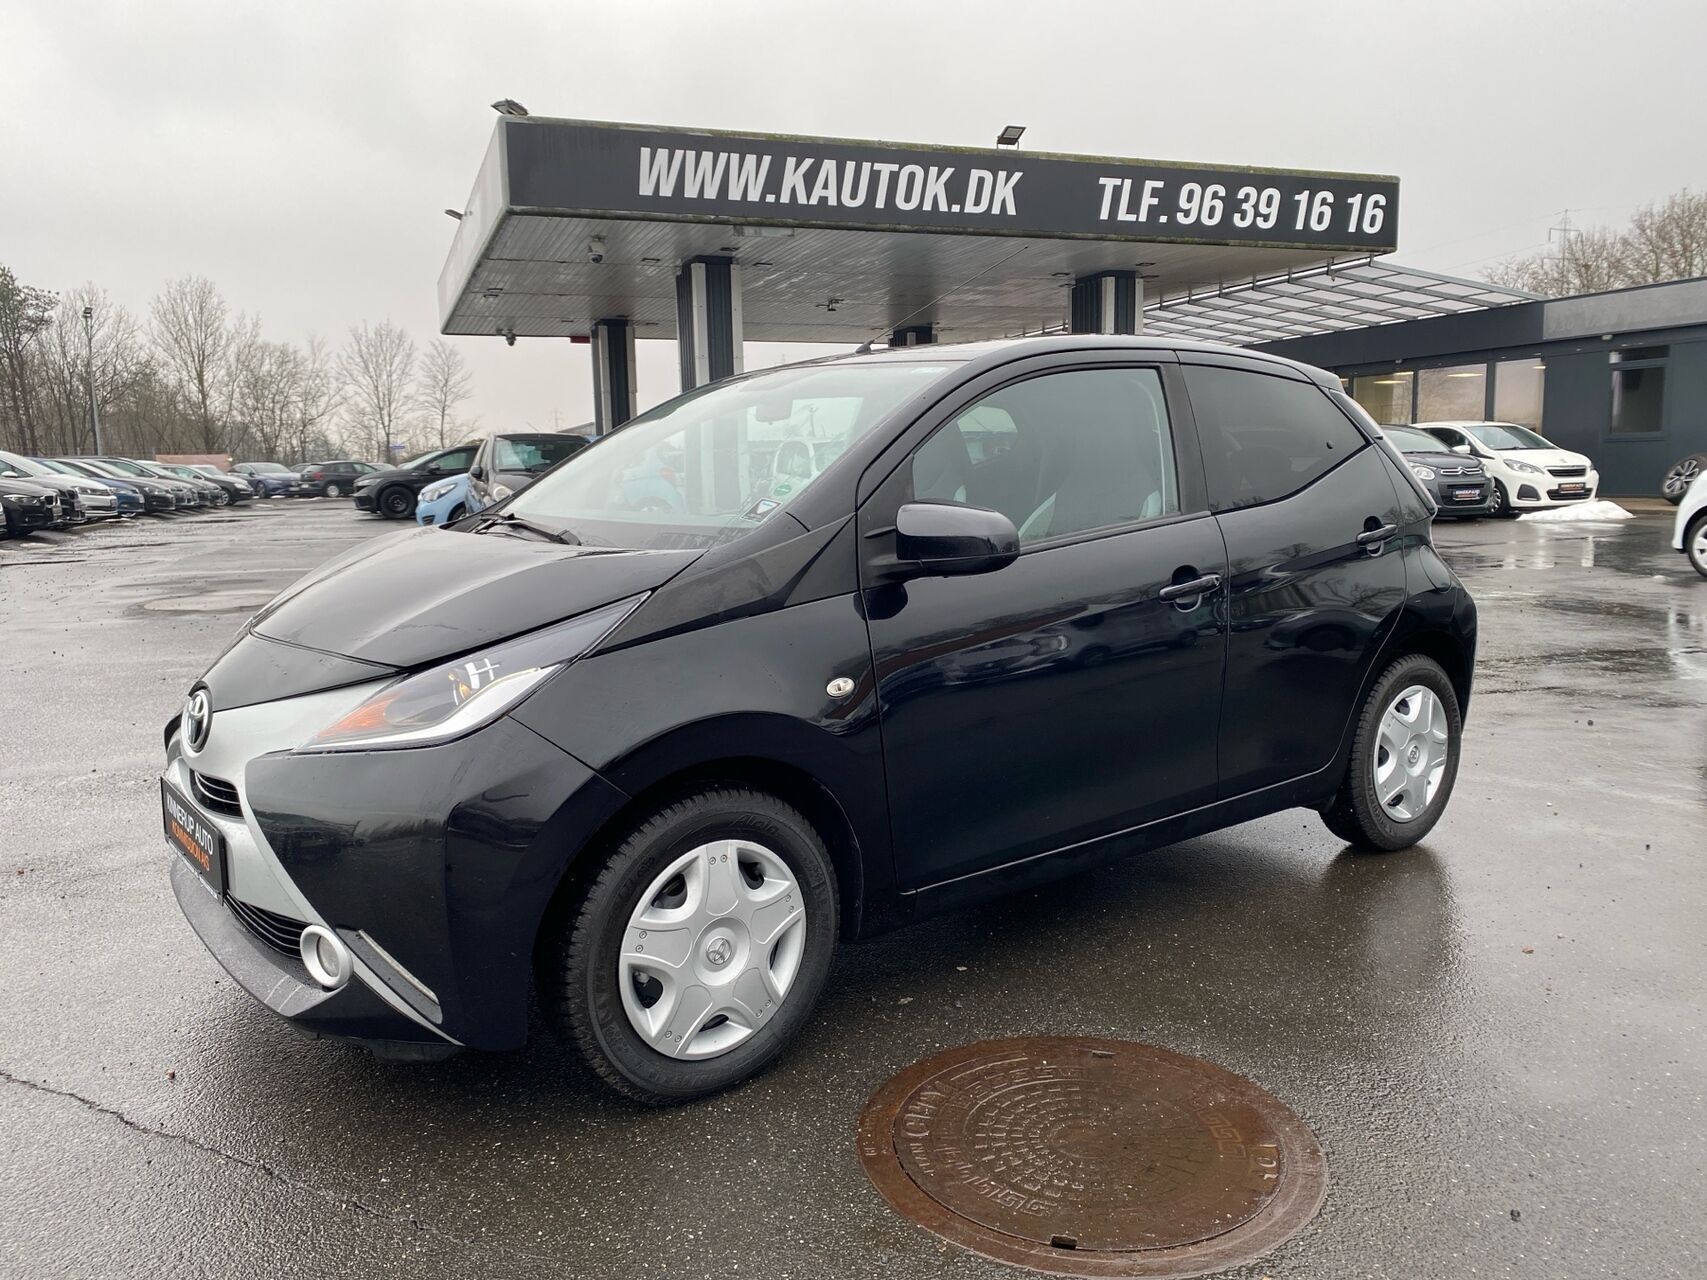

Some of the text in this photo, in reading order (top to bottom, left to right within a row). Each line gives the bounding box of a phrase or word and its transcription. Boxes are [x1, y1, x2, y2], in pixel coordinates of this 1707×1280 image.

[639, 147, 1023, 215] WWW.KAUTOK.DK
[1099, 177, 1387, 234] TLF. 96 39 16 16
[195, 822, 213, 855] AUTO
